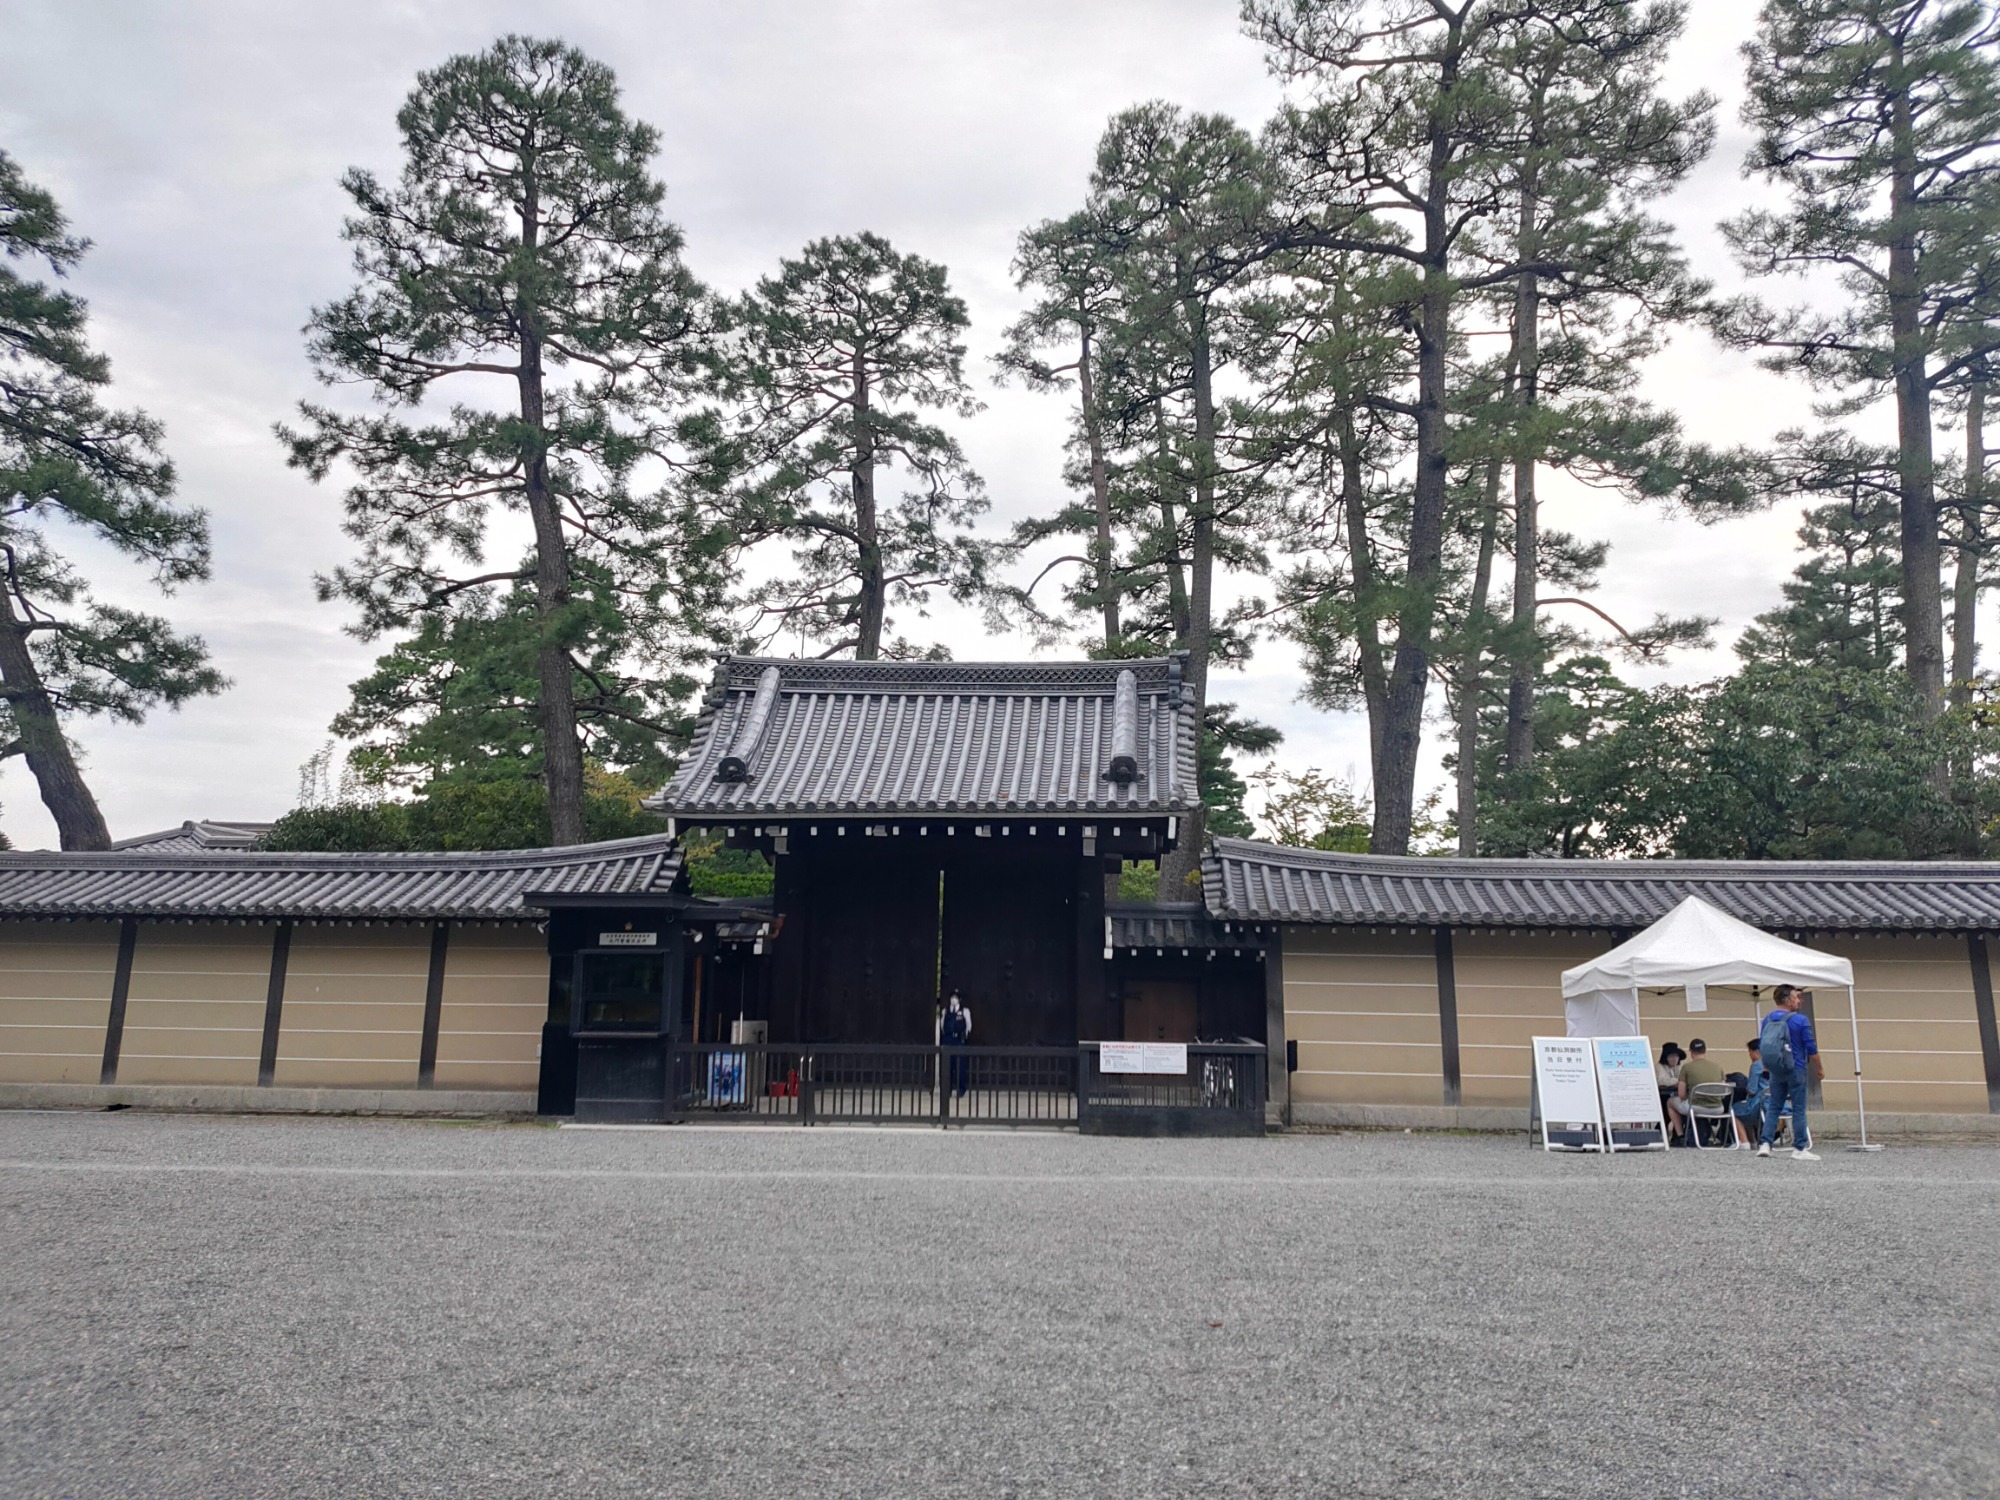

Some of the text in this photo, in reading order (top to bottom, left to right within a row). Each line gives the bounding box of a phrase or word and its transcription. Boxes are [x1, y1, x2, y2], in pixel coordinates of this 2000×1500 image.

[1544, 1046, 1583, 1054] 京都仙洞御所
[1547, 1056, 1582, 1064] 当日受付
